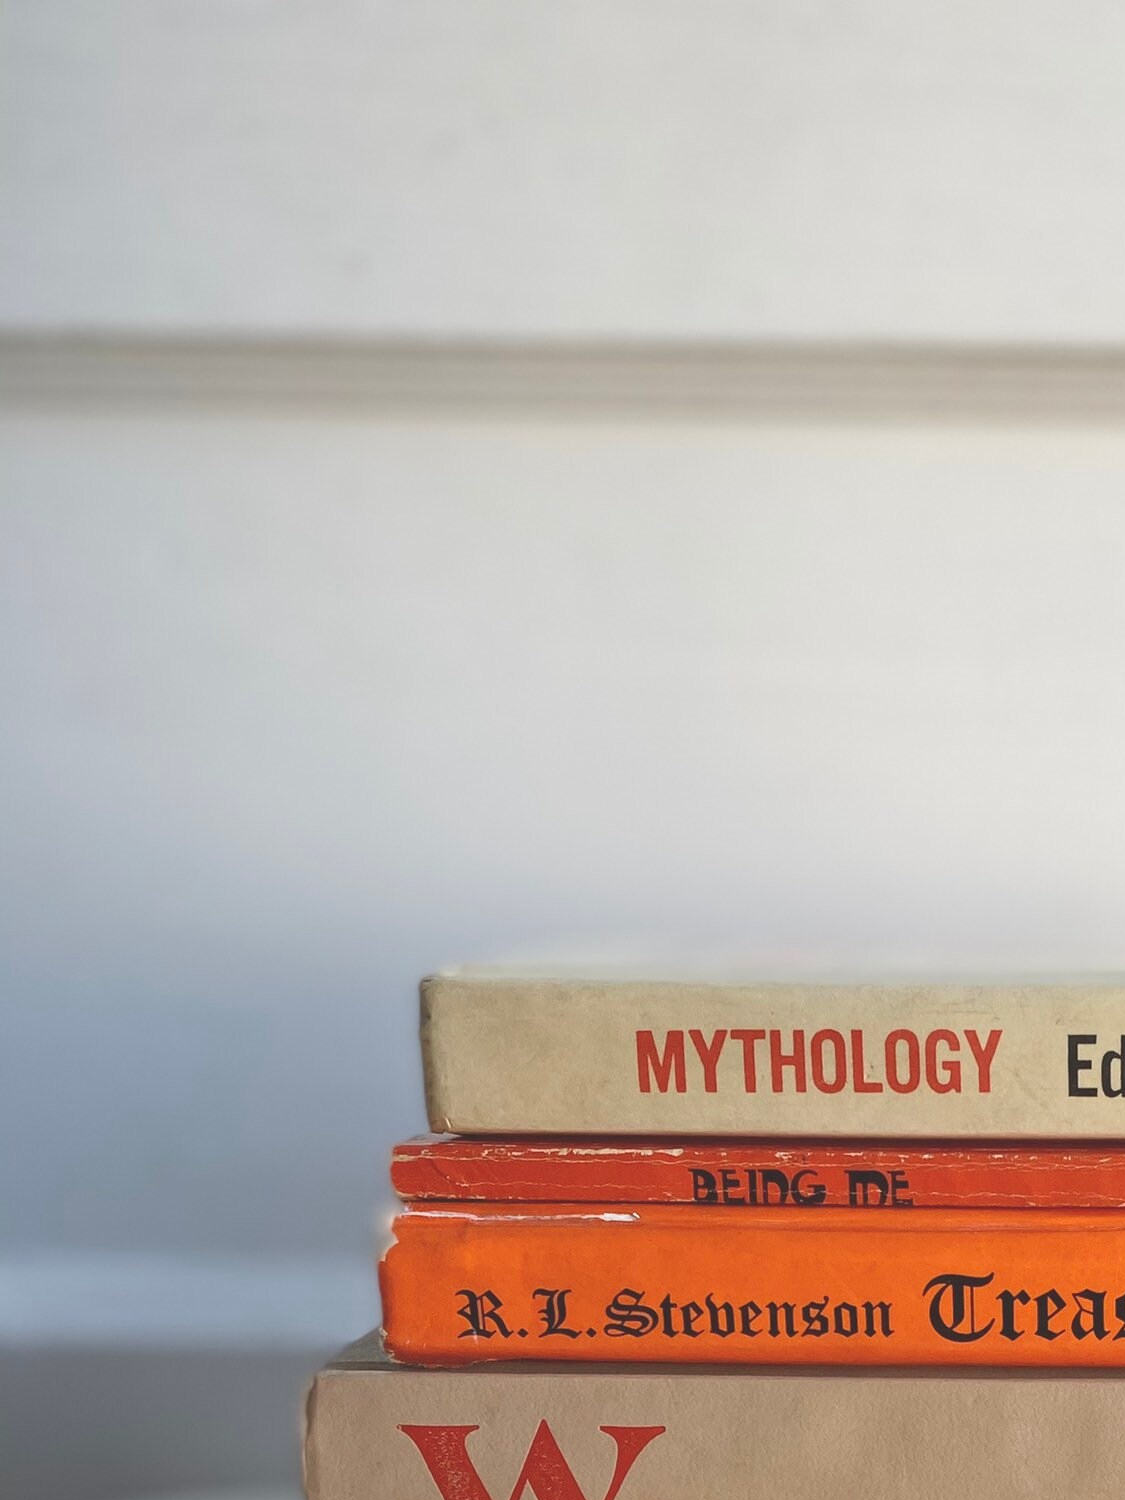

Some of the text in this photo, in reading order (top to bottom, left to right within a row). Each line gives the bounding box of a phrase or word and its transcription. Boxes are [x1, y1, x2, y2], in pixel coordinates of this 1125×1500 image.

[636, 1029, 1002, 1094] MYTHOLOGY
[688, 1168, 913, 1207] BEING ME
